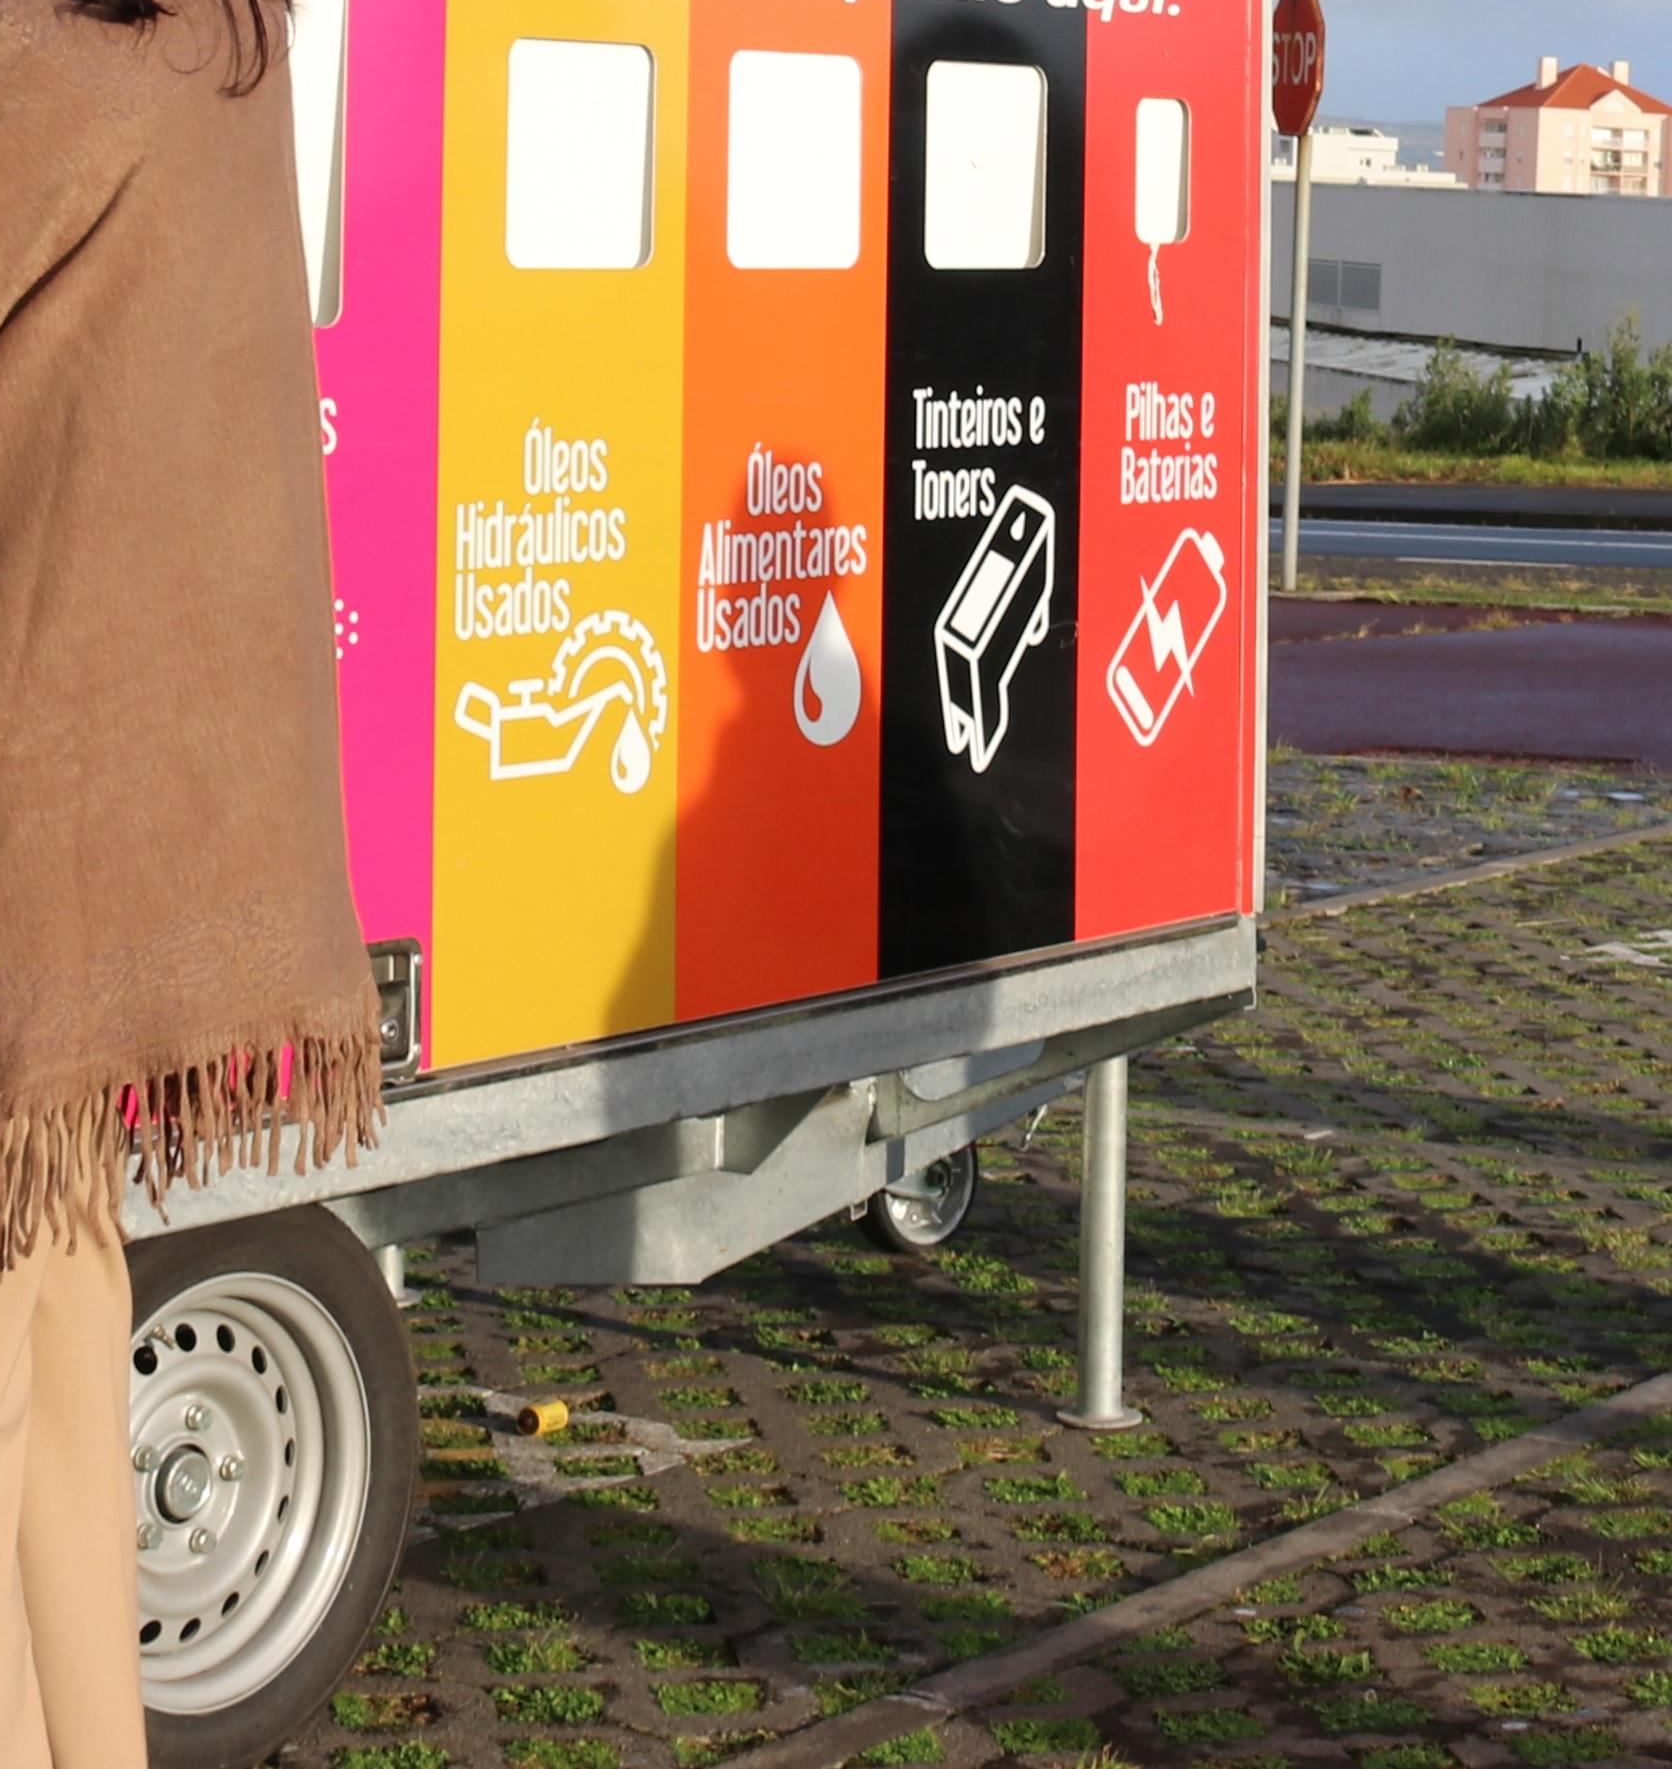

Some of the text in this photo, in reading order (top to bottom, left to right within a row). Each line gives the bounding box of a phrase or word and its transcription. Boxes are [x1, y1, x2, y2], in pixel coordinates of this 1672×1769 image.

[912, 385, 1046, 450] Tinteiros e
[1125, 381, 1216, 441] Pilhas e
[523, 417, 608, 495] Óleos
[746, 442, 823, 516] Óleos
[911, 458, 996, 520] Toners
[1120, 443, 1218, 505] Baterias
[455, 498, 626, 570] Hidráulicos
[698, 520, 868, 586] Alimentares
[455, 566, 571, 640] Usados
[696, 582, 801, 653] Usados
